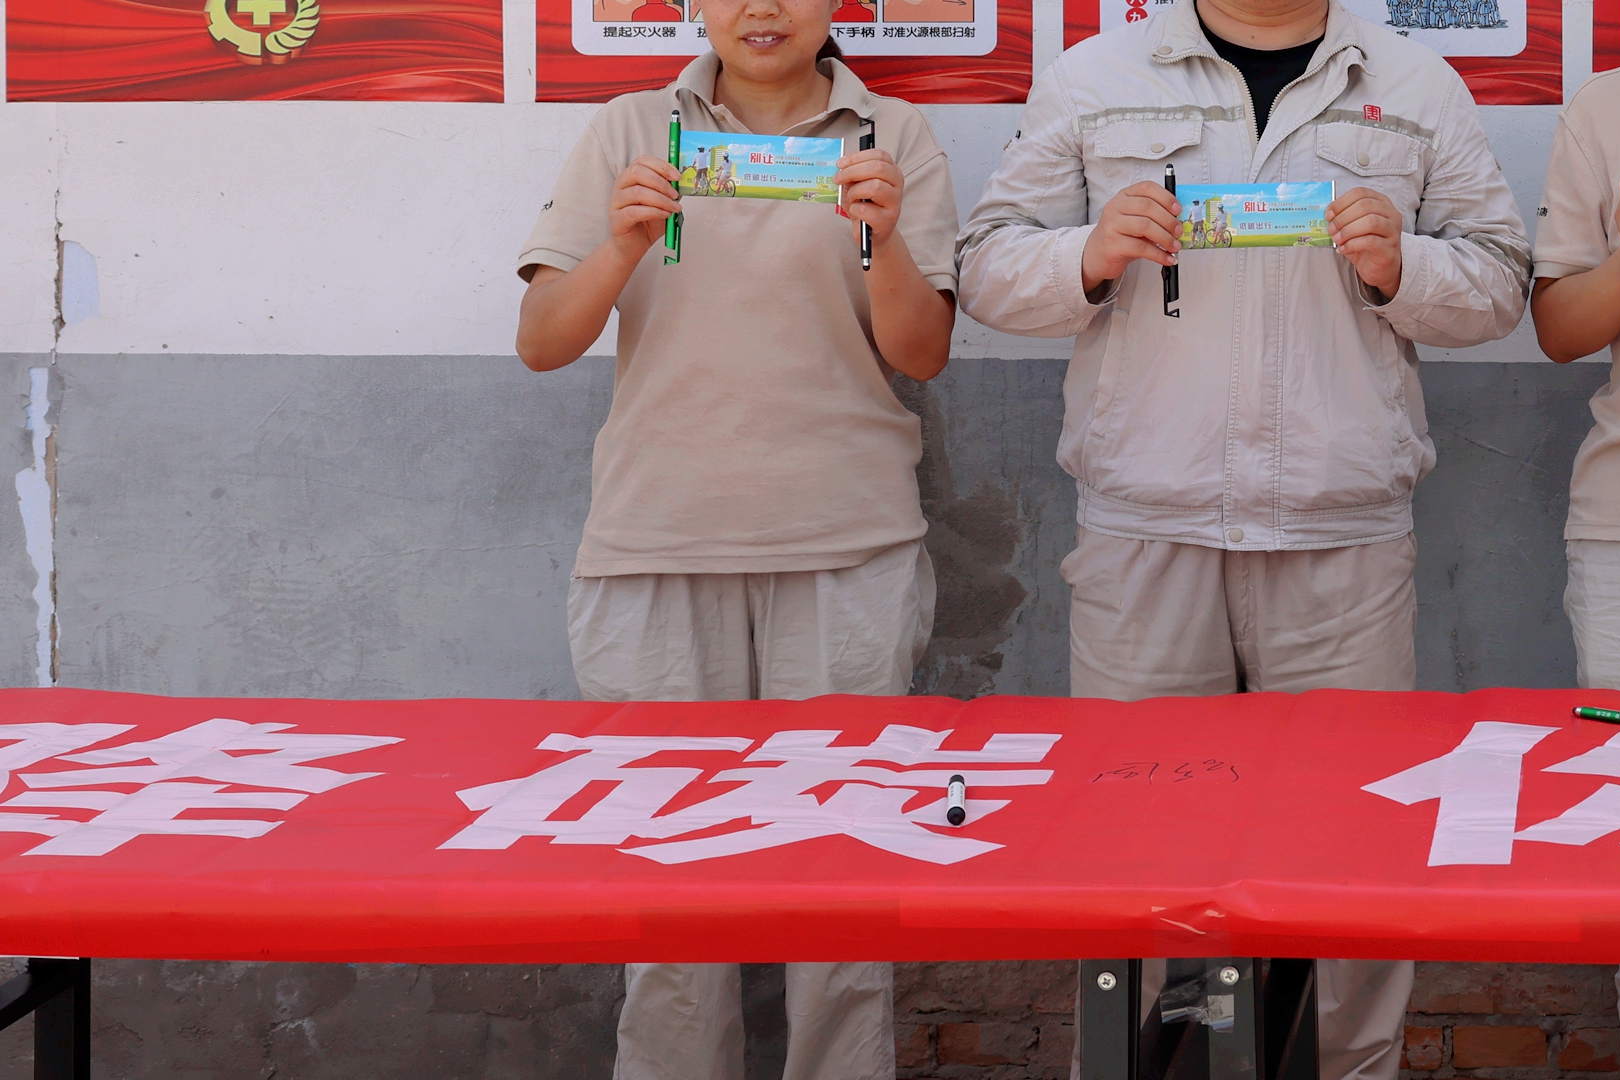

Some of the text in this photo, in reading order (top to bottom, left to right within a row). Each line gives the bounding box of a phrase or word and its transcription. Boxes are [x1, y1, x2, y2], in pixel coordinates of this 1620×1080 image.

[603, 26, 676, 39] 提起灭火器
[882, 26, 975, 39] 对准火源根部扫射
[750, 152, 774, 164] 别让
[1244, 202, 1268, 212] 别让
